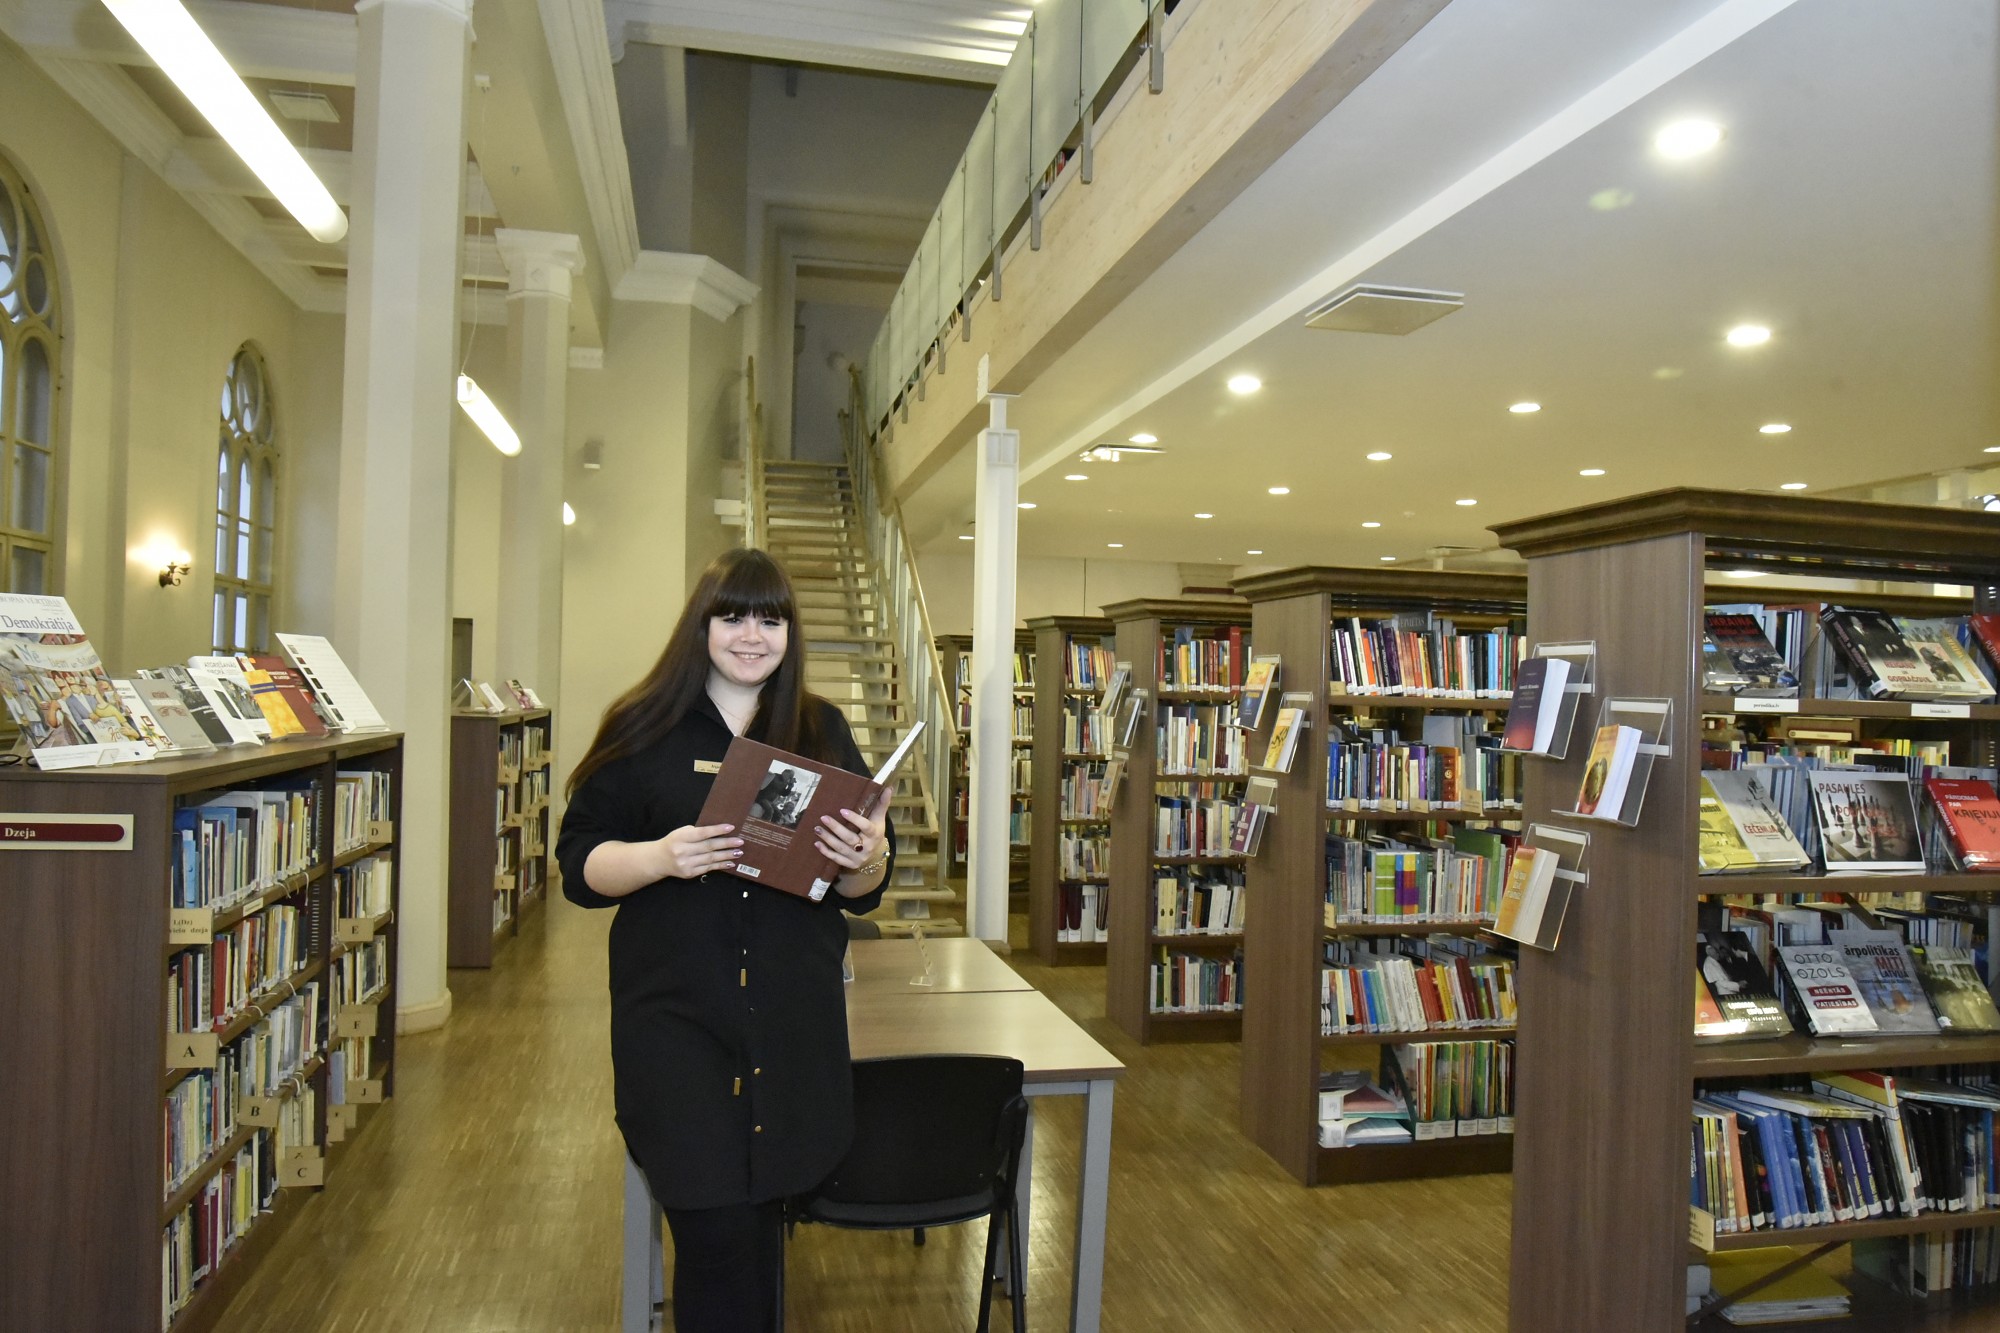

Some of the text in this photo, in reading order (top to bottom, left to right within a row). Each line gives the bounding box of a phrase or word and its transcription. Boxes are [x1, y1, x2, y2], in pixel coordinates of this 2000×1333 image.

[0, 614, 76, 633] Demokrātija
[1818, 782, 1866, 794] PASAULES
[4, 827, 37, 840] Dzeja
[371, 828, 379, 837] D
[1742, 822, 1778, 835] ČEČENIJA
[190, 926, 208, 935] dzeja
[351, 926, 359, 934] E
[1843, 945, 1900, 958] ārpolitikas
[1794, 952, 1833, 965] OTTO
[1874, 956, 1906, 971] MITI
[1796, 966, 1846, 979] OZOLS
[1815, 998, 1857, 1008] PATIESĪBAS
[354, 1020, 361, 1030] F
[183, 1045, 196, 1059] A
[361, 1087, 367, 1097] J
[250, 1105, 261, 1118] B
[297, 1167, 308, 1179] C
